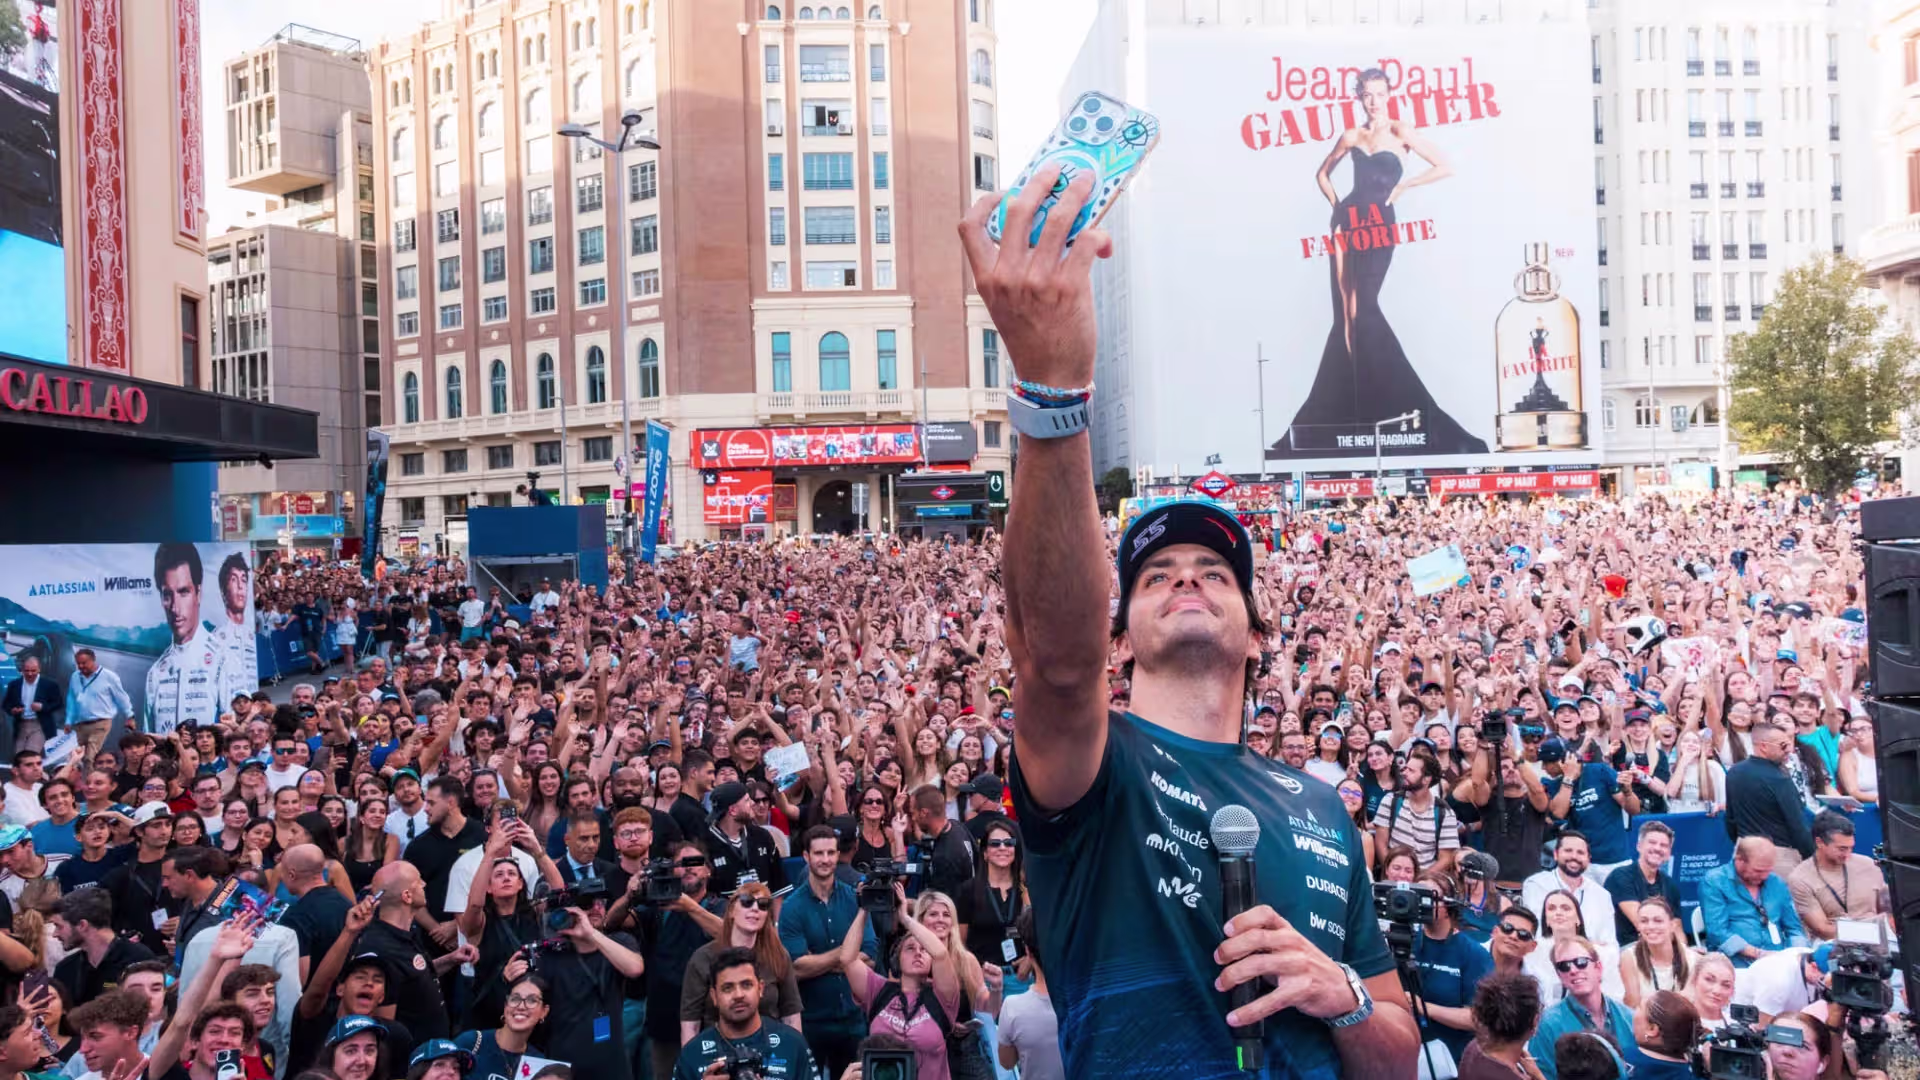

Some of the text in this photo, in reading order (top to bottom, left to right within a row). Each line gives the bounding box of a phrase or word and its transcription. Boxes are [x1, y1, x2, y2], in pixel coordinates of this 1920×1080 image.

[1266, 56, 1477, 101] Jean Paul
[1348, 202, 1385, 229] LA
[1300, 218, 1437, 259] FAVORITE
[1555, 248, 1576, 258] NEW
[1503, 355, 1577, 379] FAVORITE
[0, 367, 148, 424] CALLAO
[1336, 433, 1426, 448] THE NEW RAGRANCE
[1321, 482, 1359, 494] GUYS
[1440, 477, 1481, 489] POP MART
[1496, 475, 1537, 488] POP MART
[1552, 474, 1592, 486] POP MART
[1129, 512, 1169, 562] 55
[39, 576, 152, 596] ATLASSIAN Williams
[1293, 833, 1349, 866] Williams
